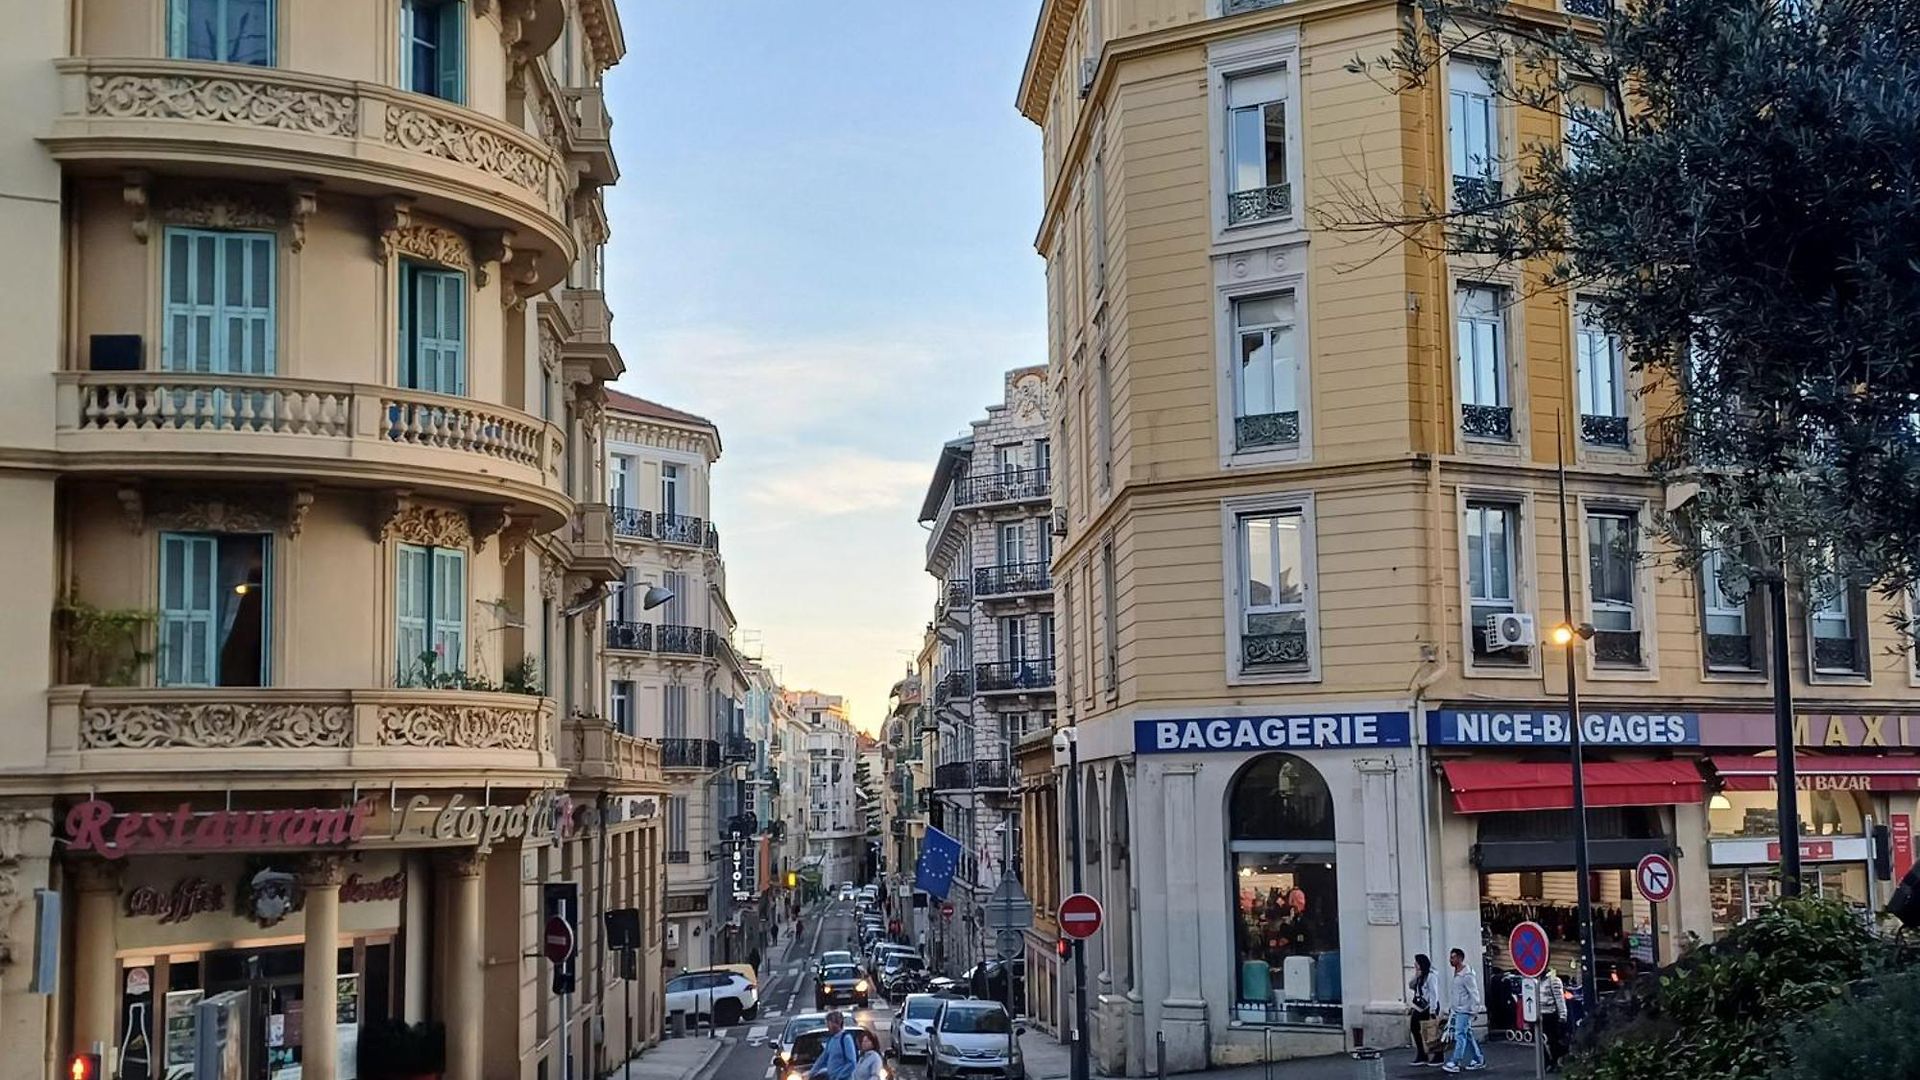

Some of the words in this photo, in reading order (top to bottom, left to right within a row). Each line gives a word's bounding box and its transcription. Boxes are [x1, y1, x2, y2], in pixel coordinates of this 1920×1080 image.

[1157, 716, 1378, 749] BAGAGERIE
[1769, 776, 1811, 790] MXI
[1816, 775, 1870, 790] BAZAR
[65, 798, 369, 859] Restaurant
